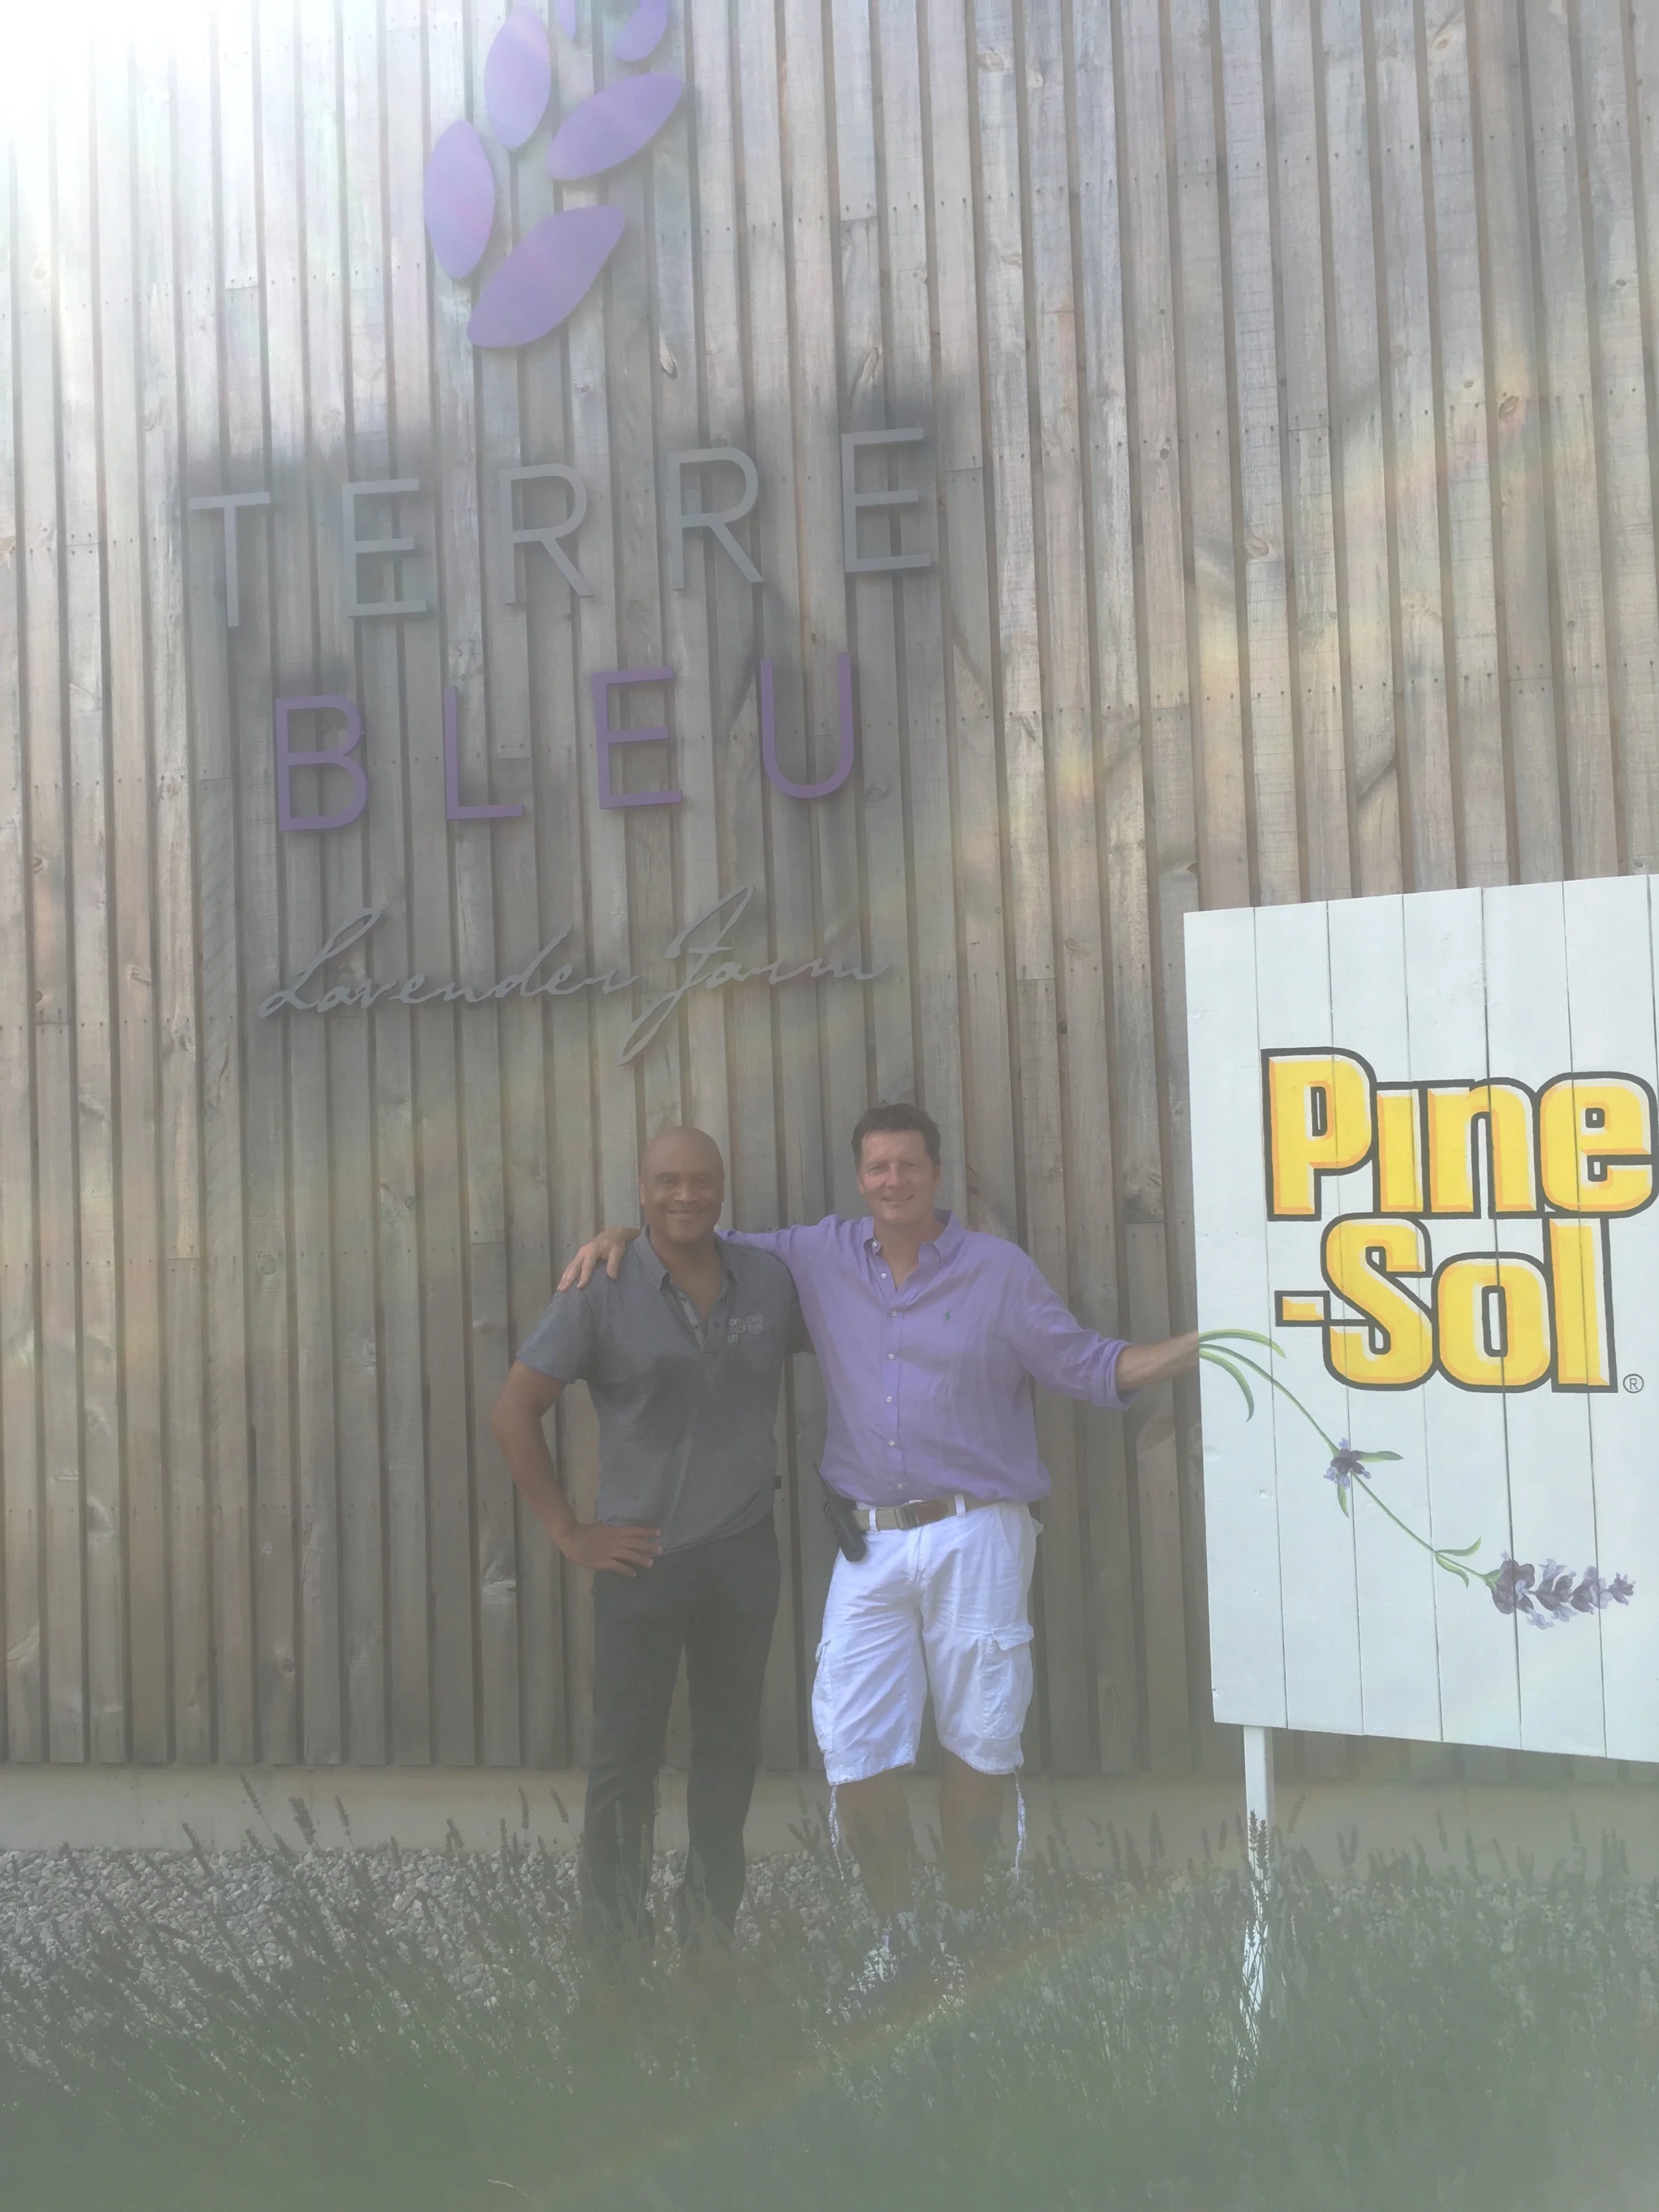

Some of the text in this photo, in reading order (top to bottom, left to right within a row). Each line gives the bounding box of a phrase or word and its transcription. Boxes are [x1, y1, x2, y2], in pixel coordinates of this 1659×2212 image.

[188, 426, 932, 628] TERRE
[275, 651, 855, 832] BLEU
[260, 884, 890, 1066] Lavender Farm
[1261, 1047, 1658, 1221] Pine
